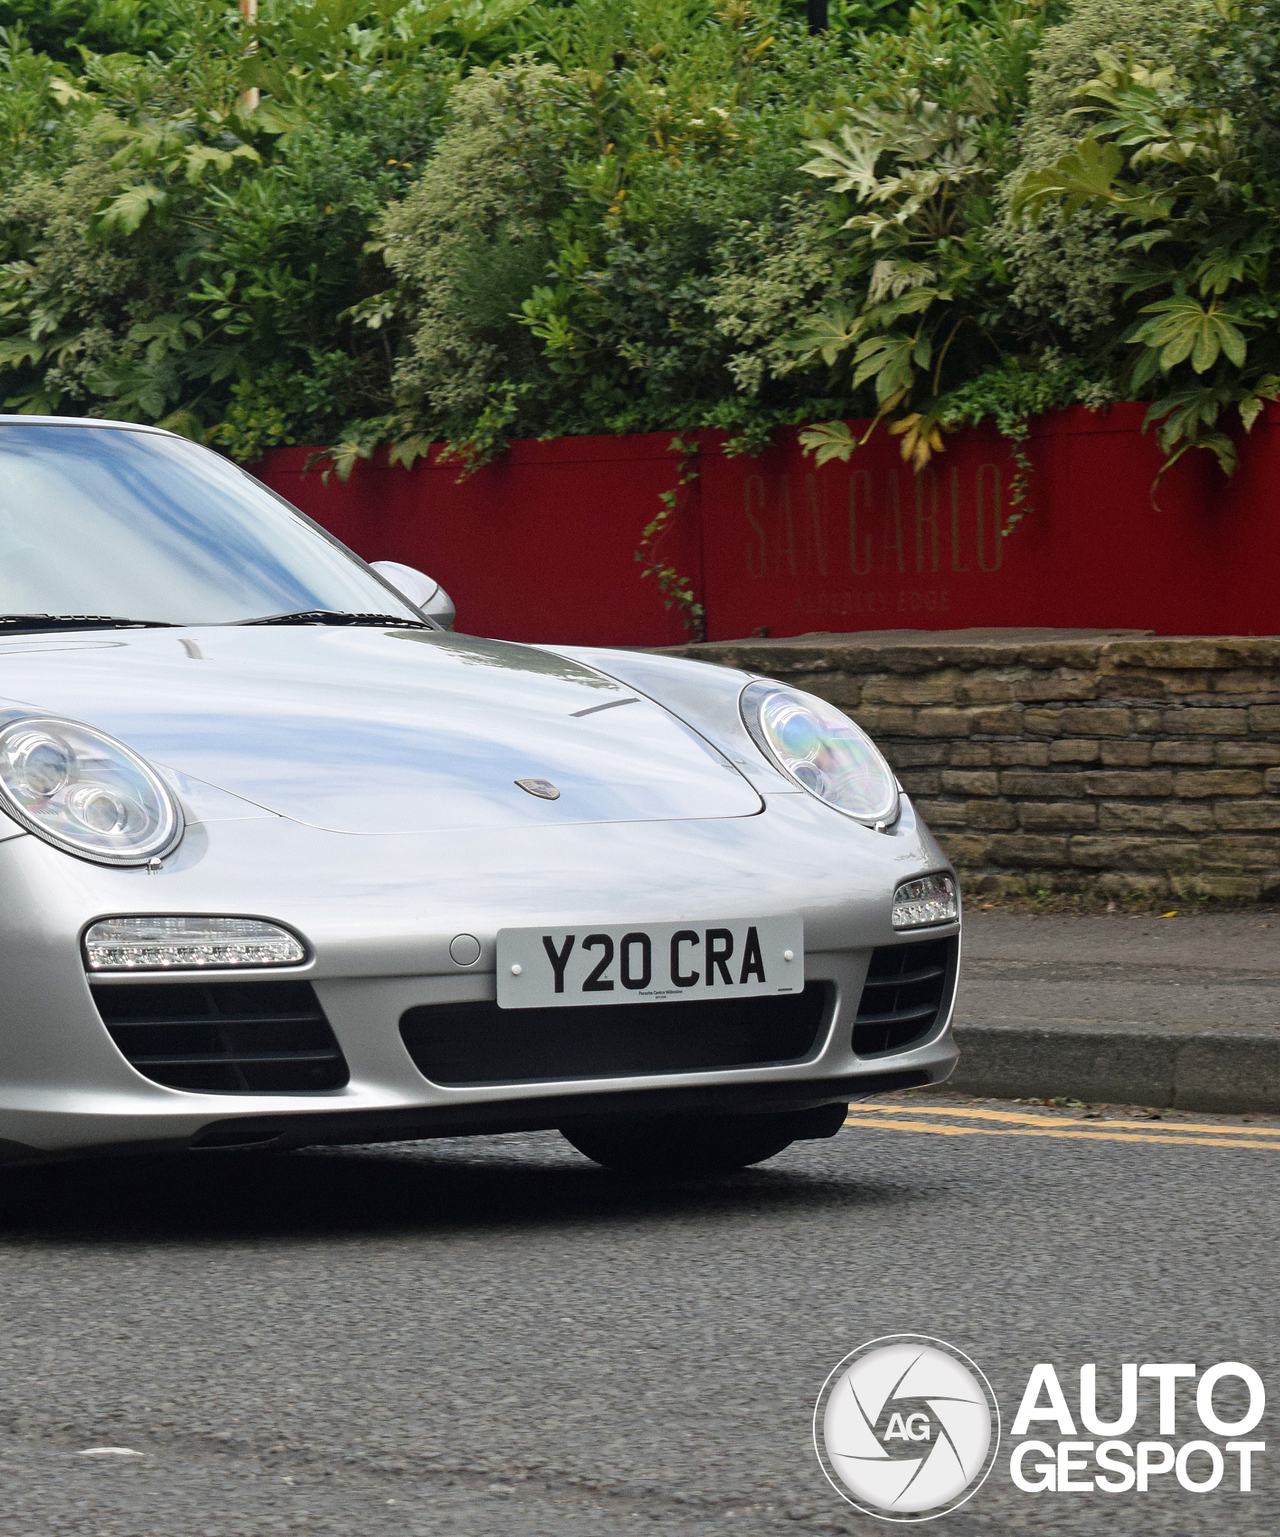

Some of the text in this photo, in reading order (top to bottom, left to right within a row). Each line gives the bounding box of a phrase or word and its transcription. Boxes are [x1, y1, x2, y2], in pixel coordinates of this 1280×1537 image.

[745, 463, 1003, 577] SAN CARLO
[896, 589, 951, 613] EDGE
[542, 926, 767, 993] Y20 CRA
